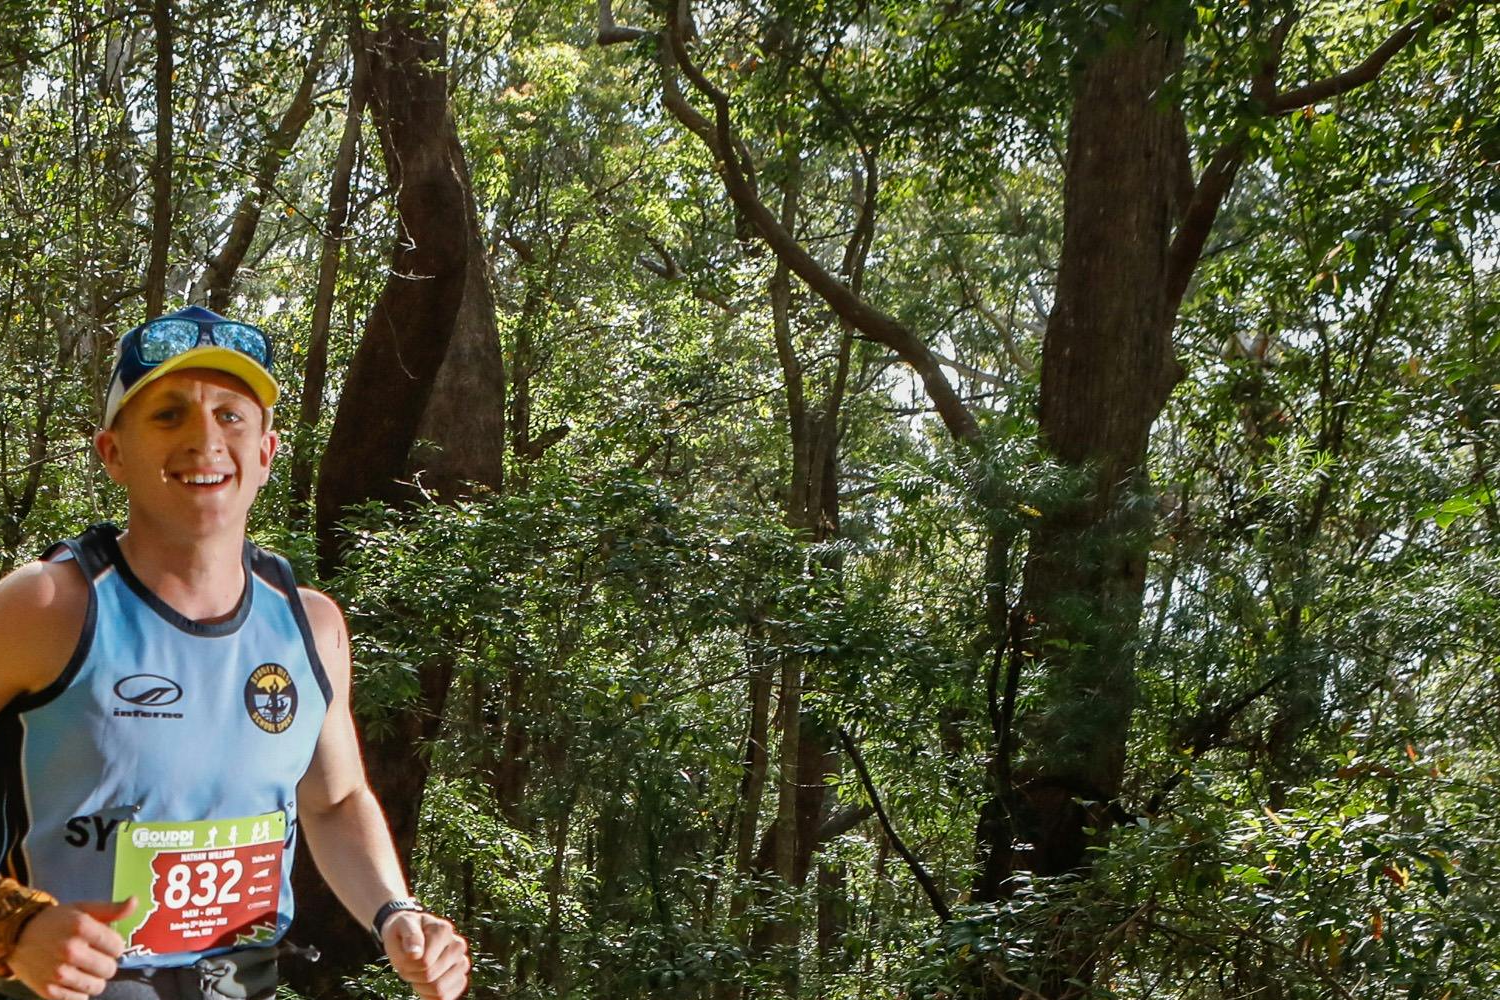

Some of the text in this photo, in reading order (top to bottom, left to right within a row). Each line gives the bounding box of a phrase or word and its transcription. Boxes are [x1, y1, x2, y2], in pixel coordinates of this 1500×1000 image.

[113, 707, 183, 719] inferno
[138, 829, 195, 843] BOUDDI
[164, 859, 243, 909] 832
